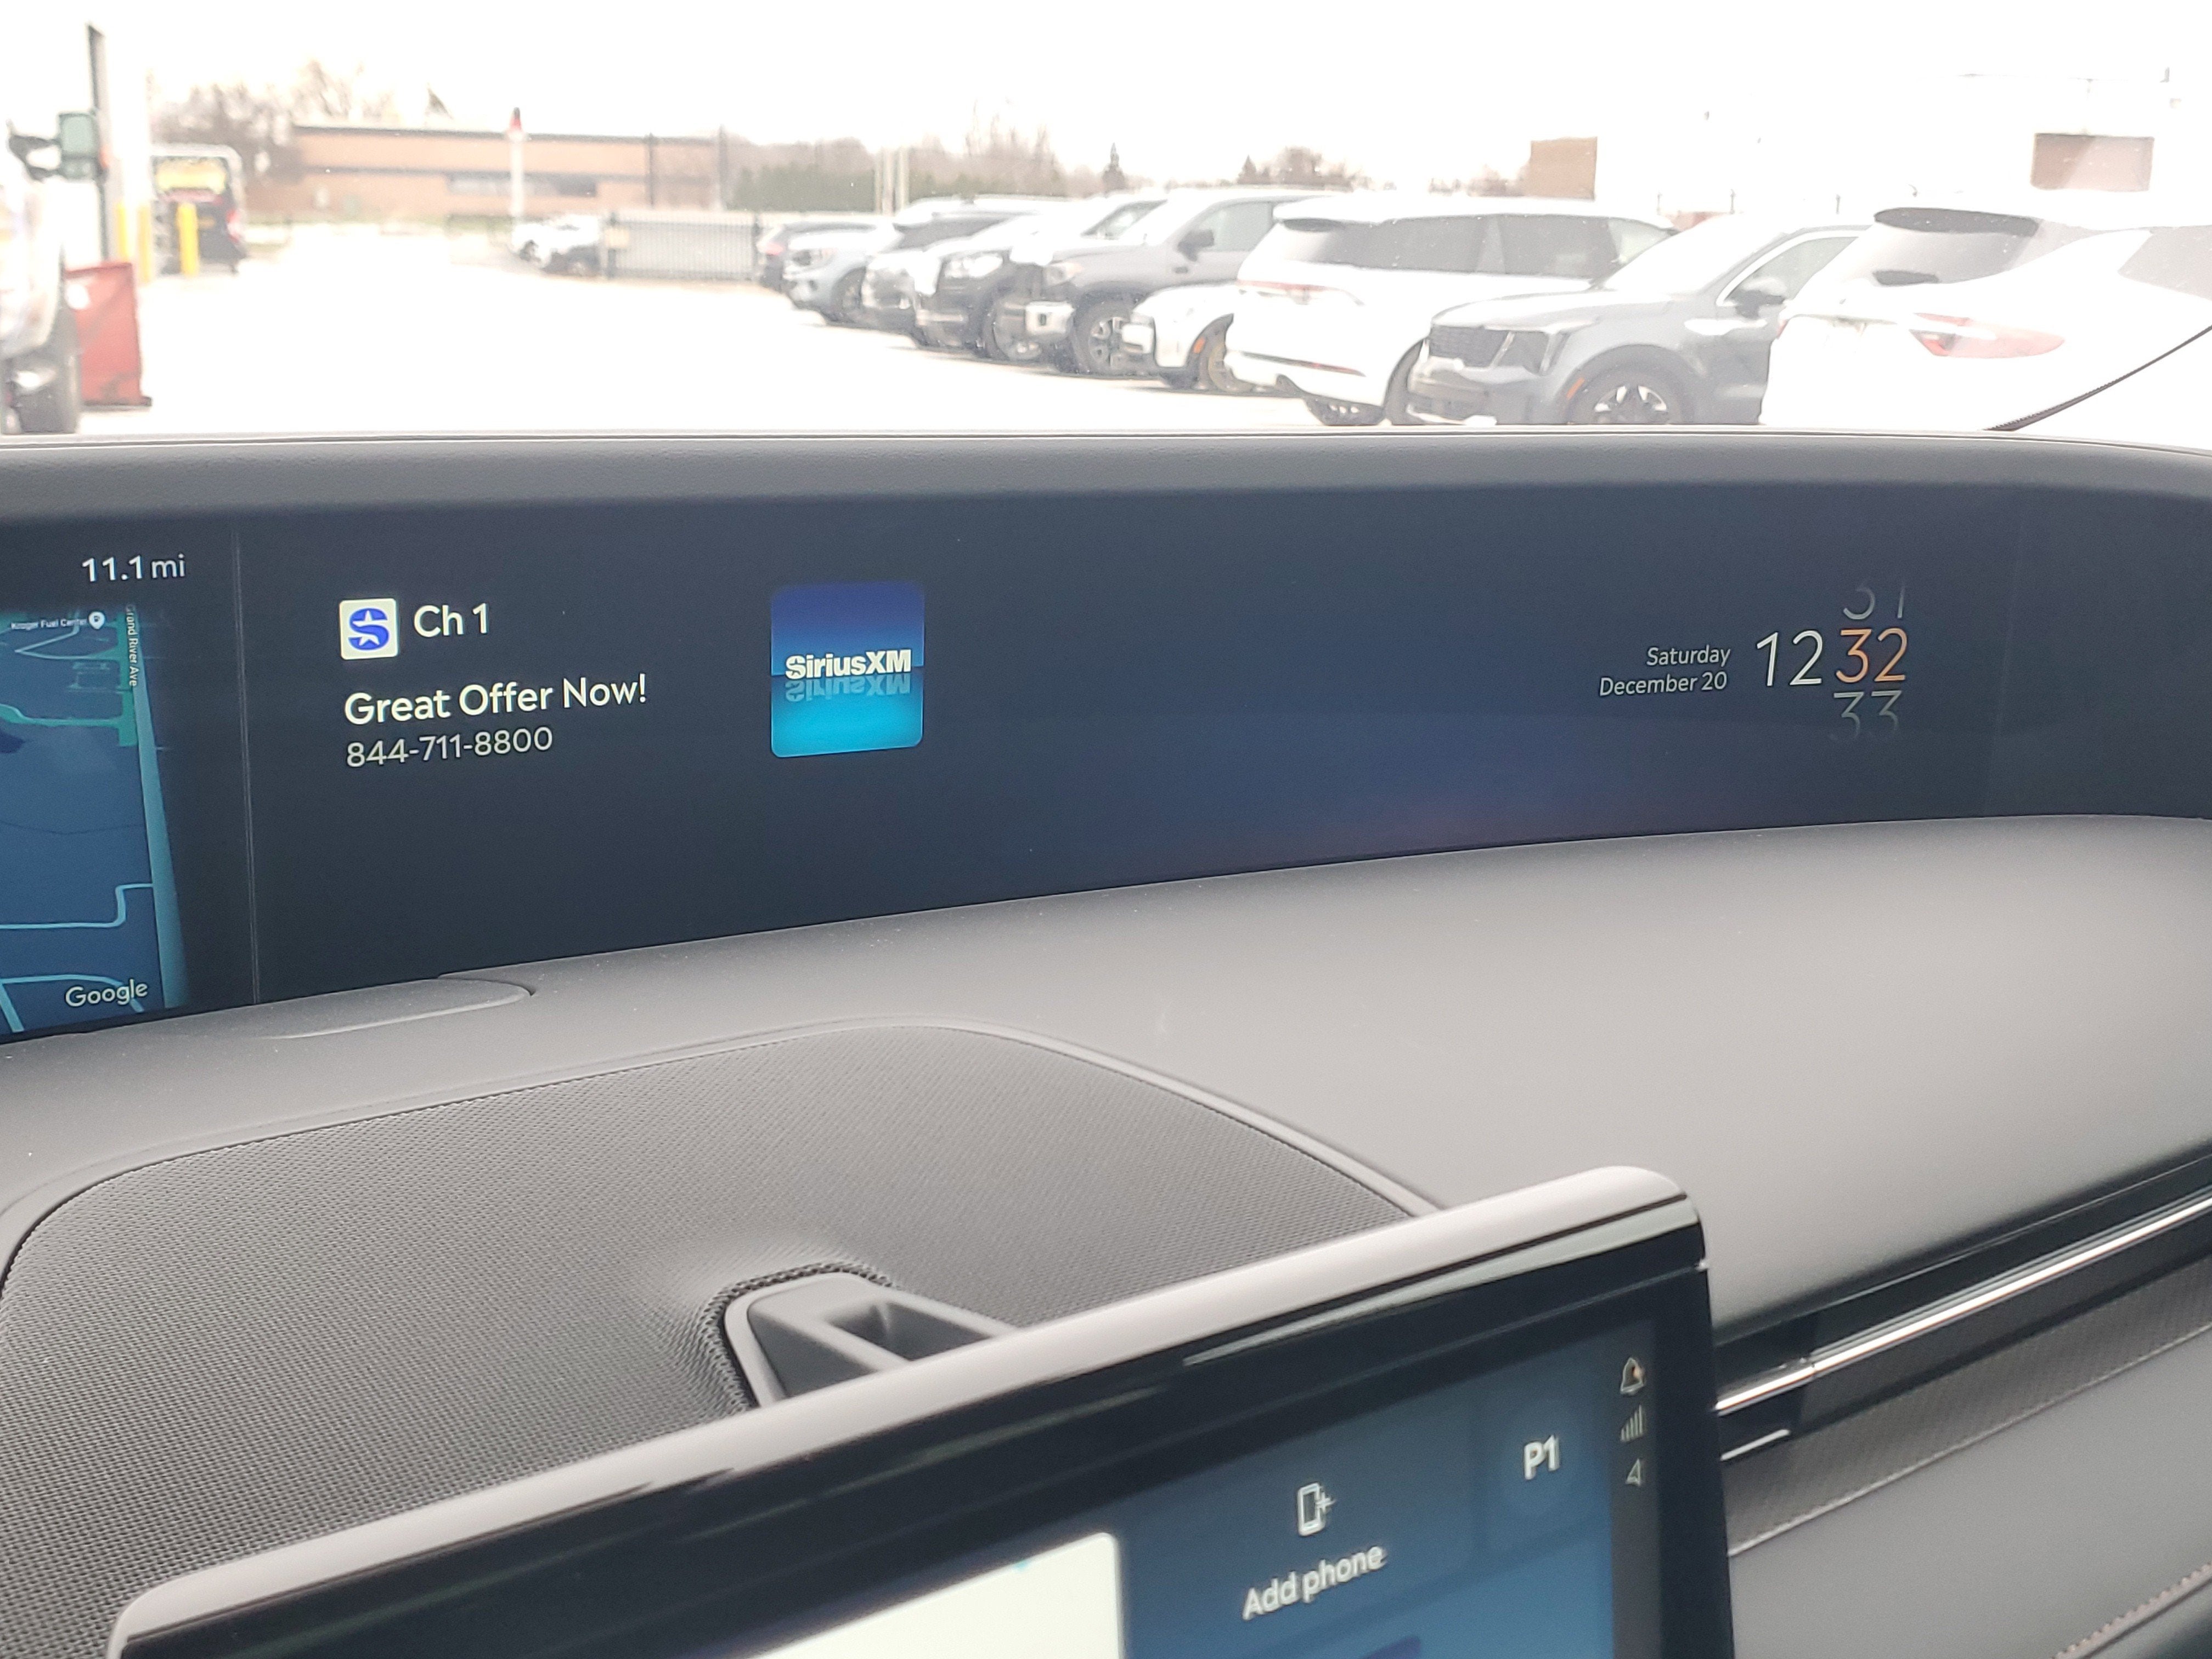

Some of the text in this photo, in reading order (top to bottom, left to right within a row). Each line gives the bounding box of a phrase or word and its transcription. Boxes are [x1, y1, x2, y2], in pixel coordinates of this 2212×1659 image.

[81, 553, 186, 582] 11.1 mi
[414, 602, 489, 638] Ch 1
[129, 637, 139, 663] River
[785, 649, 912, 680] SiriusXM
[1646, 644, 1731, 667] Saturday
[1756, 628, 1908, 687] 12 32
[129, 666, 139, 687] Ave
[1599, 671, 1728, 697] December 20
[344, 673, 647, 725] Great Offer Now!
[346, 726, 554, 768] 844-711-8800
[65, 978, 149, 1007] Google
[1523, 1434, 1560, 1480] P1
[1242, 1544, 1387, 1621] Add phone
